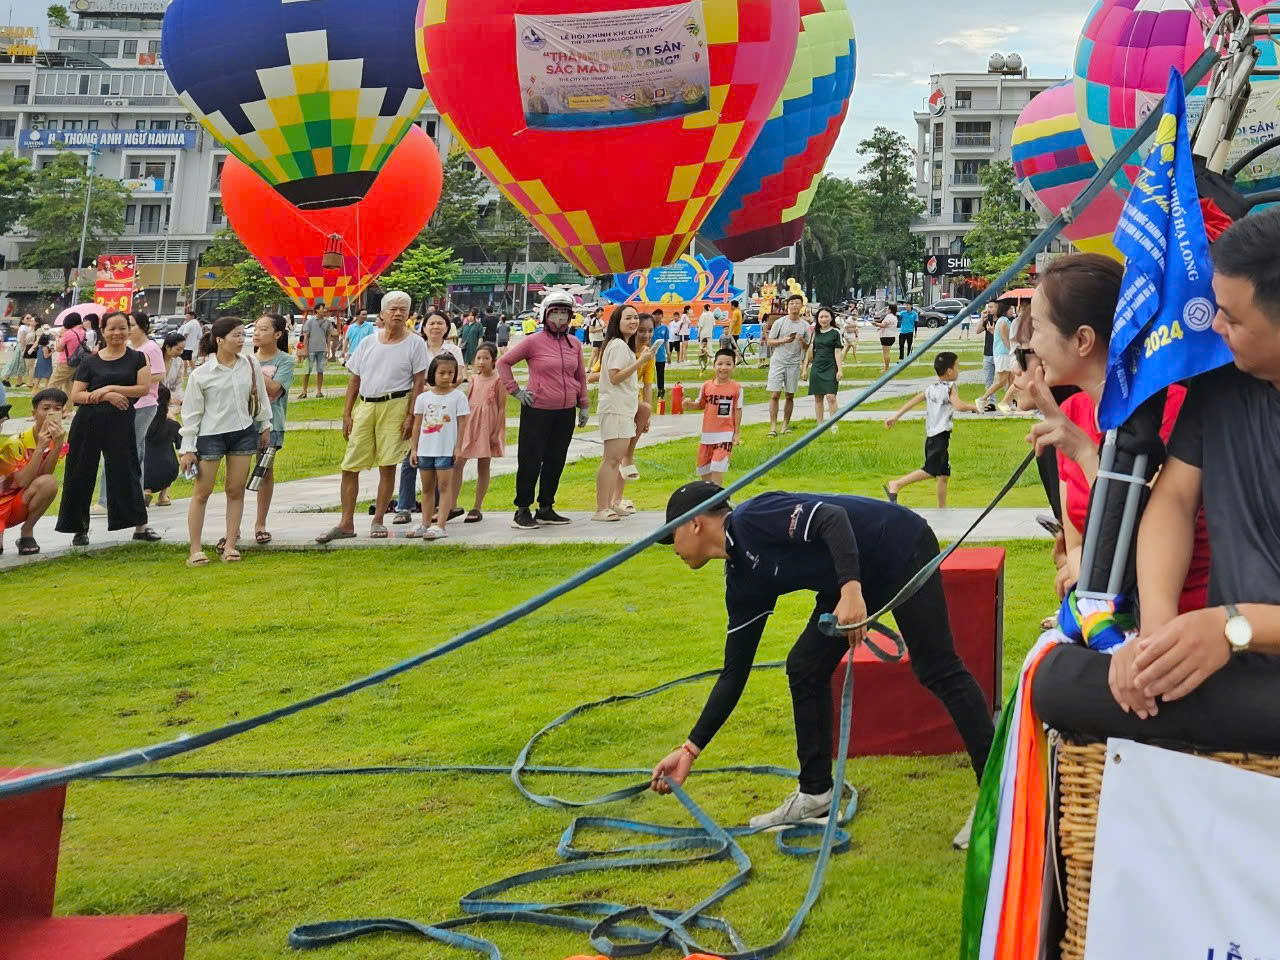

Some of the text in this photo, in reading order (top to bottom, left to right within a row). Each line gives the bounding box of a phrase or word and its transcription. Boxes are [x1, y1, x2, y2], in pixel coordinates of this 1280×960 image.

[587, 29, 611, 38] KHINH
[645, 26, 664, 35] 2024
[636, 46, 650, 57] DI
[546, 61, 573, 74] SẮC
[100, 132, 122, 145] ANH
[148, 132, 185, 145] HAVINA
[1179, 240, 1199, 281] LONG
[119, 295, 128, 312] 9
[1144, 319, 1184, 359] 2024
